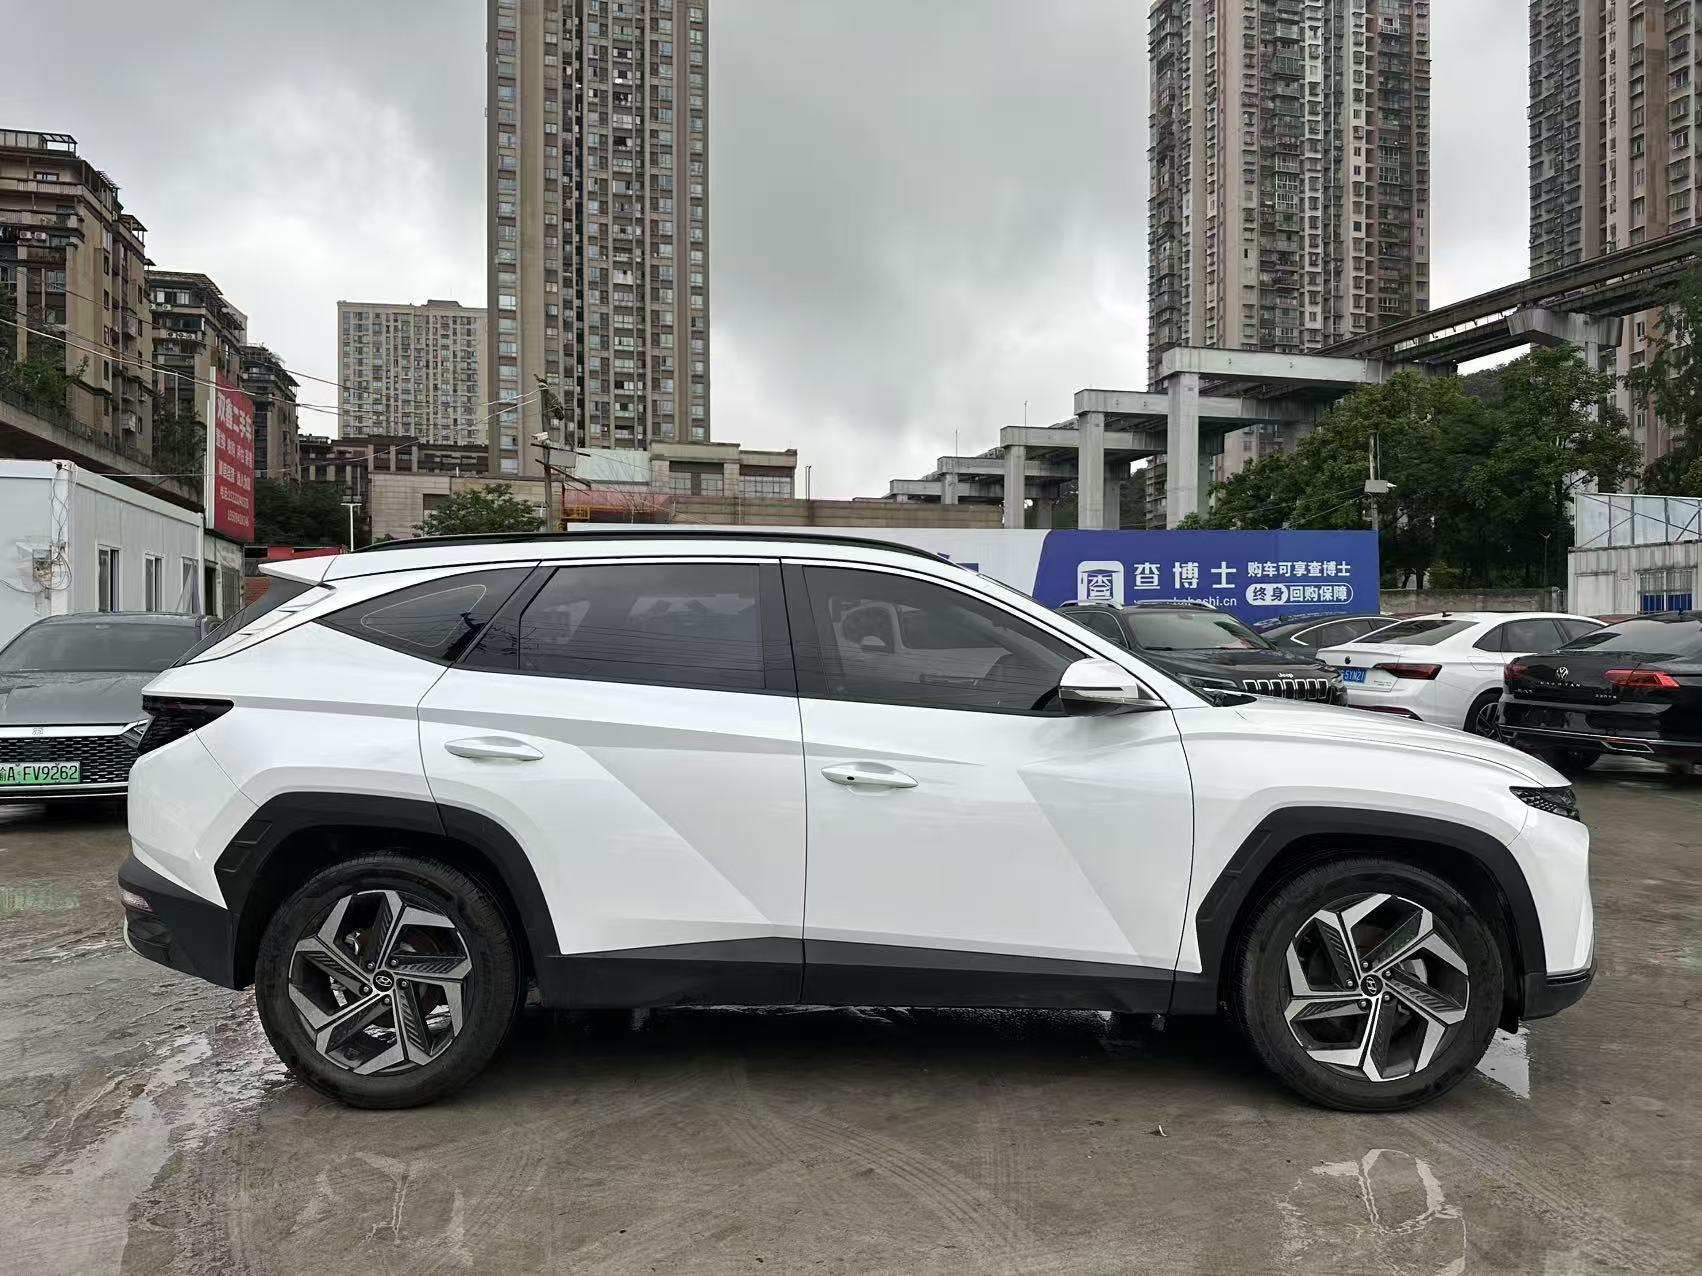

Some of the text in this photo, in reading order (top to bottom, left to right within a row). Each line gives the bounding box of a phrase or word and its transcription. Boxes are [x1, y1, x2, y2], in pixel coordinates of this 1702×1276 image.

[1133, 561, 1237, 590] 查博士
[1247, 561, 1351, 577] 购车可享查博士
